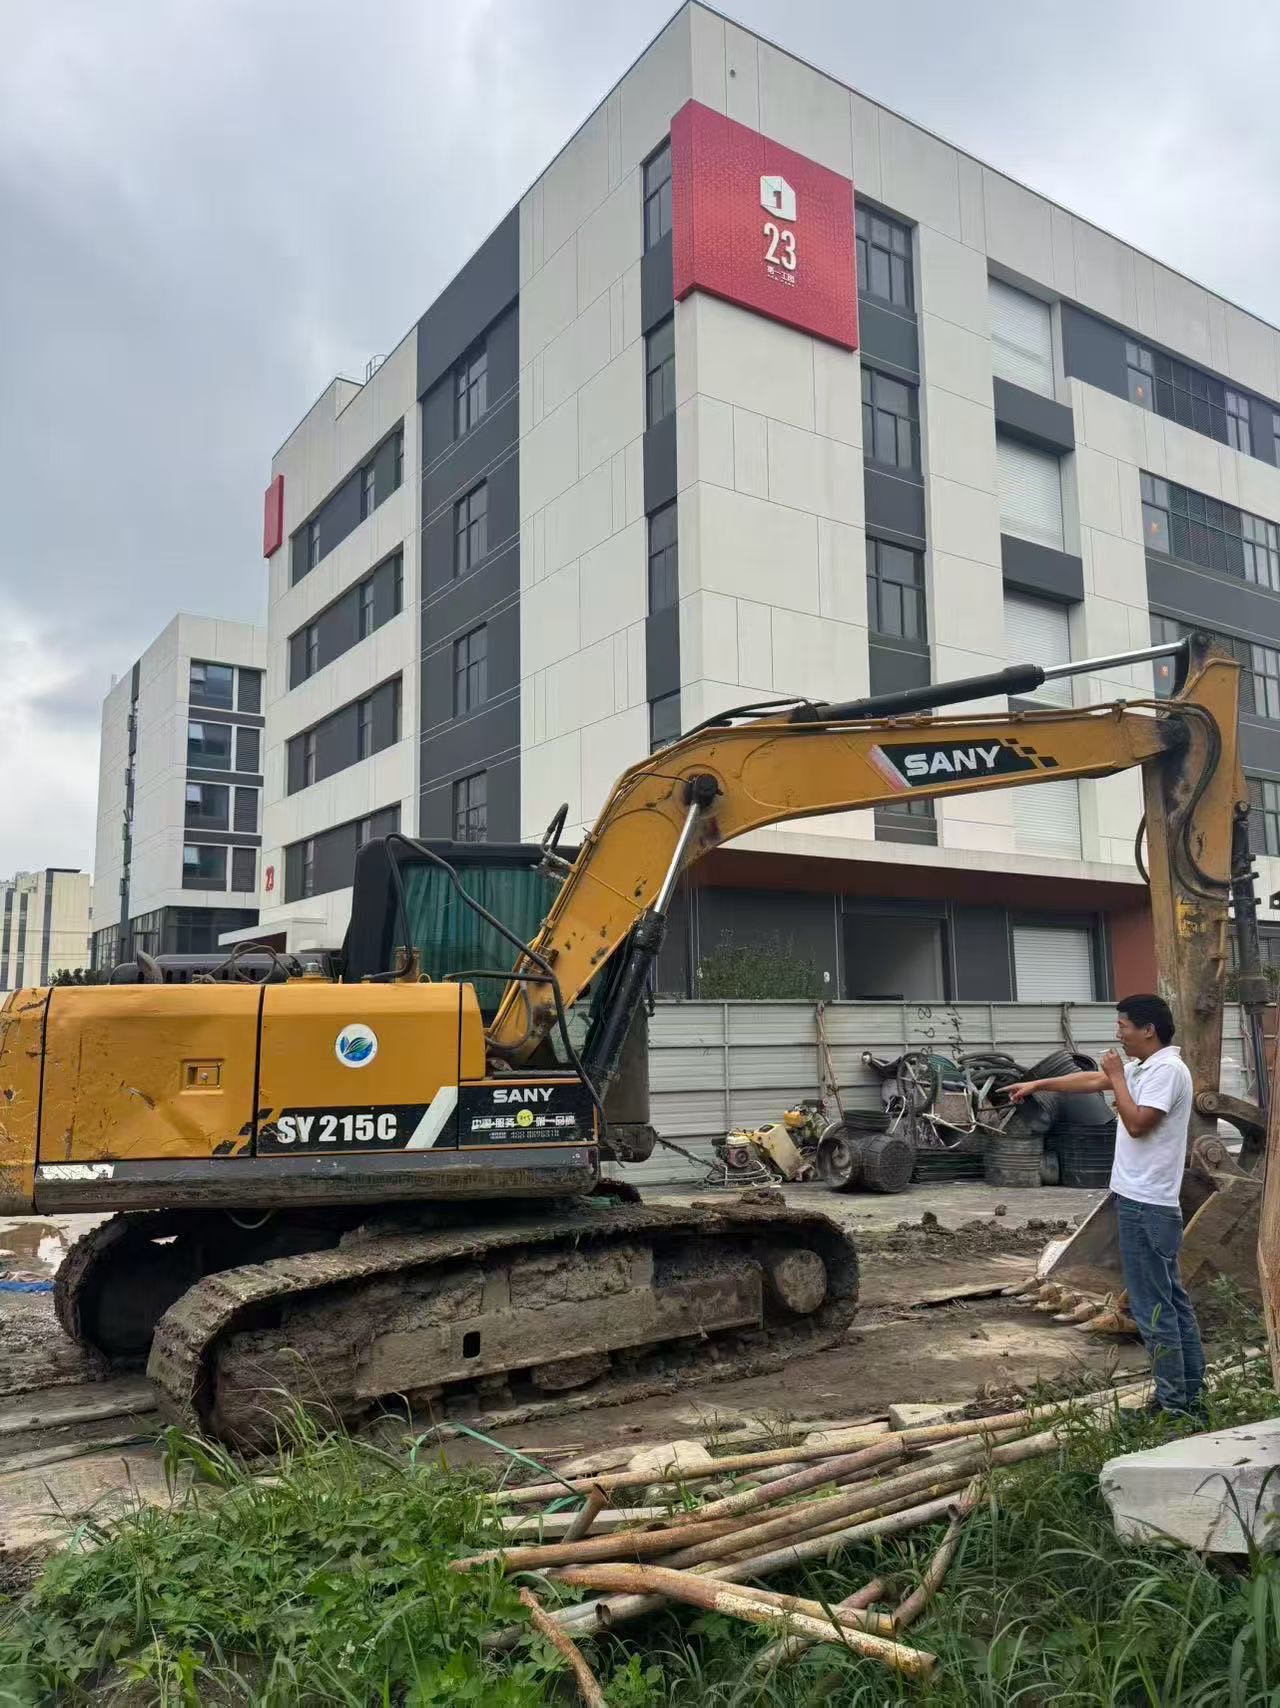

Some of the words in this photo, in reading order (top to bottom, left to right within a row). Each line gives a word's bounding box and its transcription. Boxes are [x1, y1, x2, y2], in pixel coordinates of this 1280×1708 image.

[764, 222, 796, 270] 23
[904, 745, 1000, 777] SANY
[265, 865, 275, 891] 23
[493, 1088, 554, 1103] SANY
